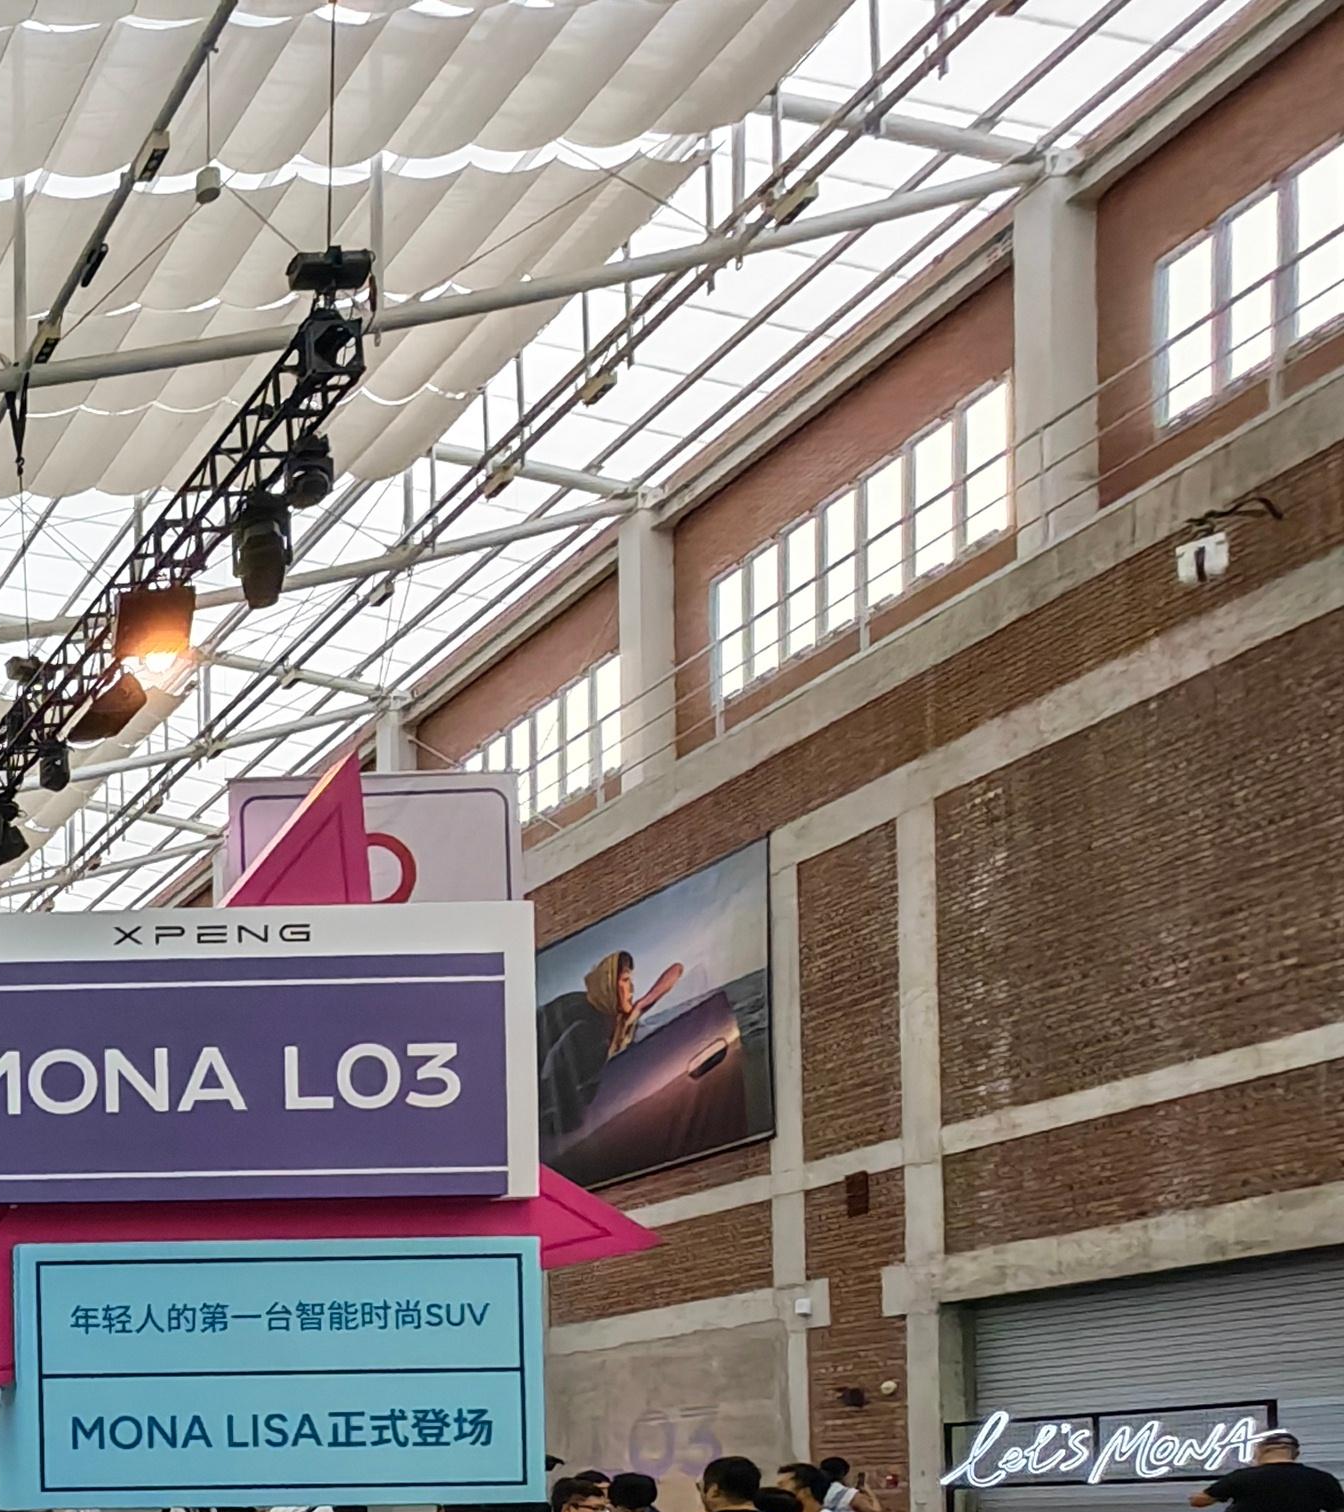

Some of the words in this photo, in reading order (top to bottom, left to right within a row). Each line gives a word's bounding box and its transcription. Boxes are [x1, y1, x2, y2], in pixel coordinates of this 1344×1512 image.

[113, 922, 311, 946] XPENG
[69, 1299, 491, 1336] 年轻人的第一台智能时尚SUV
[71, 1413, 213, 1451] MONA
[1086, 1416, 1289, 1486] MONA
